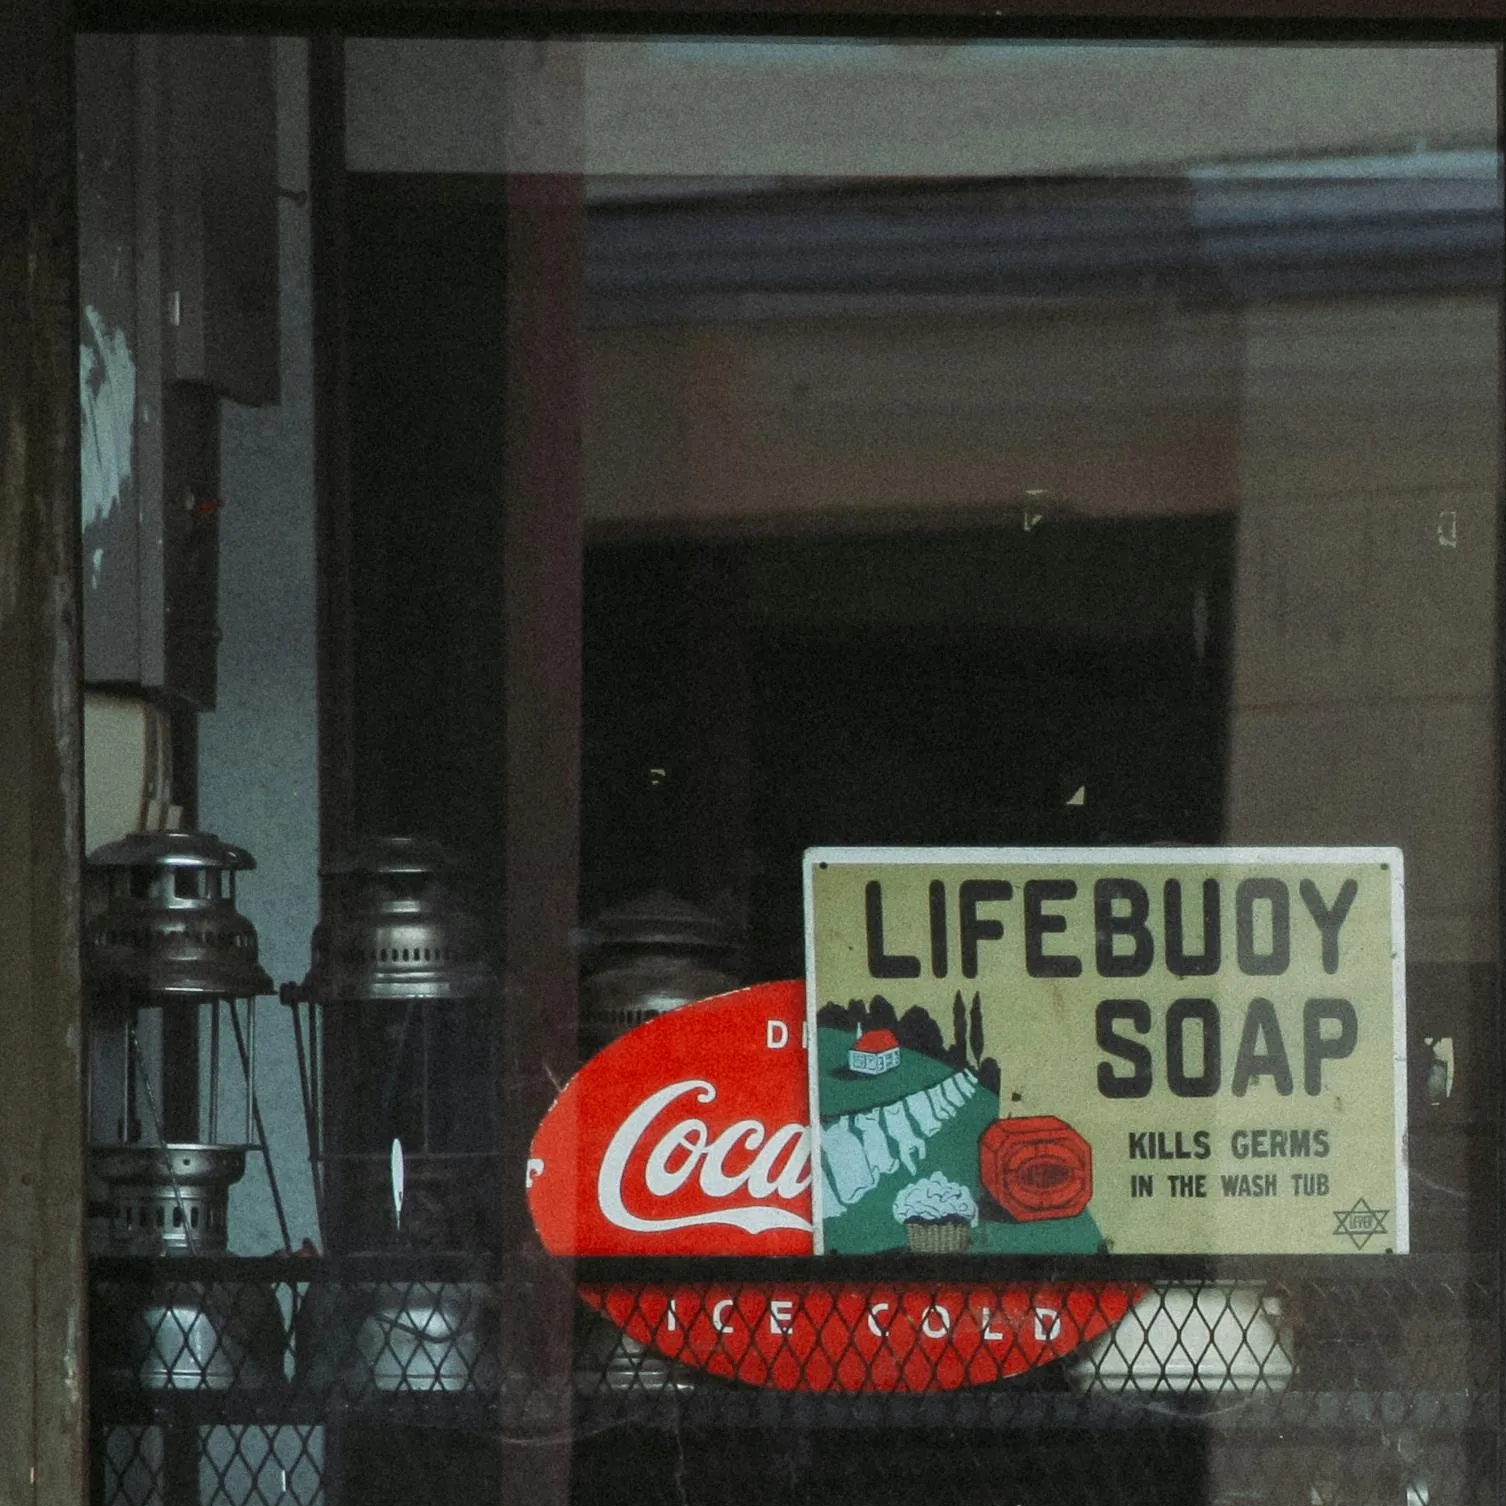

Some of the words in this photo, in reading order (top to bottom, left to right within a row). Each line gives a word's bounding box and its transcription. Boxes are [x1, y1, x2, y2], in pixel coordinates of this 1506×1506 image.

[865, 877, 1359, 979] LIFEBUOY
[1094, 997, 1359, 1099] SOAP
[598, 1079, 812, 1235] Coca
[1128, 1130, 1212, 1159] KILLS
[1231, 1129, 1331, 1159] GERMS
[1131, 1175, 1153, 1197] IN
[1168, 1174, 1208, 1197] THE
[1220, 1174, 1277, 1197] WASH
[1291, 1173, 1330, 1196] TUB
[1349, 1215, 1373, 1230] LEVER
[667, 1299, 793, 1335] ICE
[868, 1302, 1062, 1341] COLD
